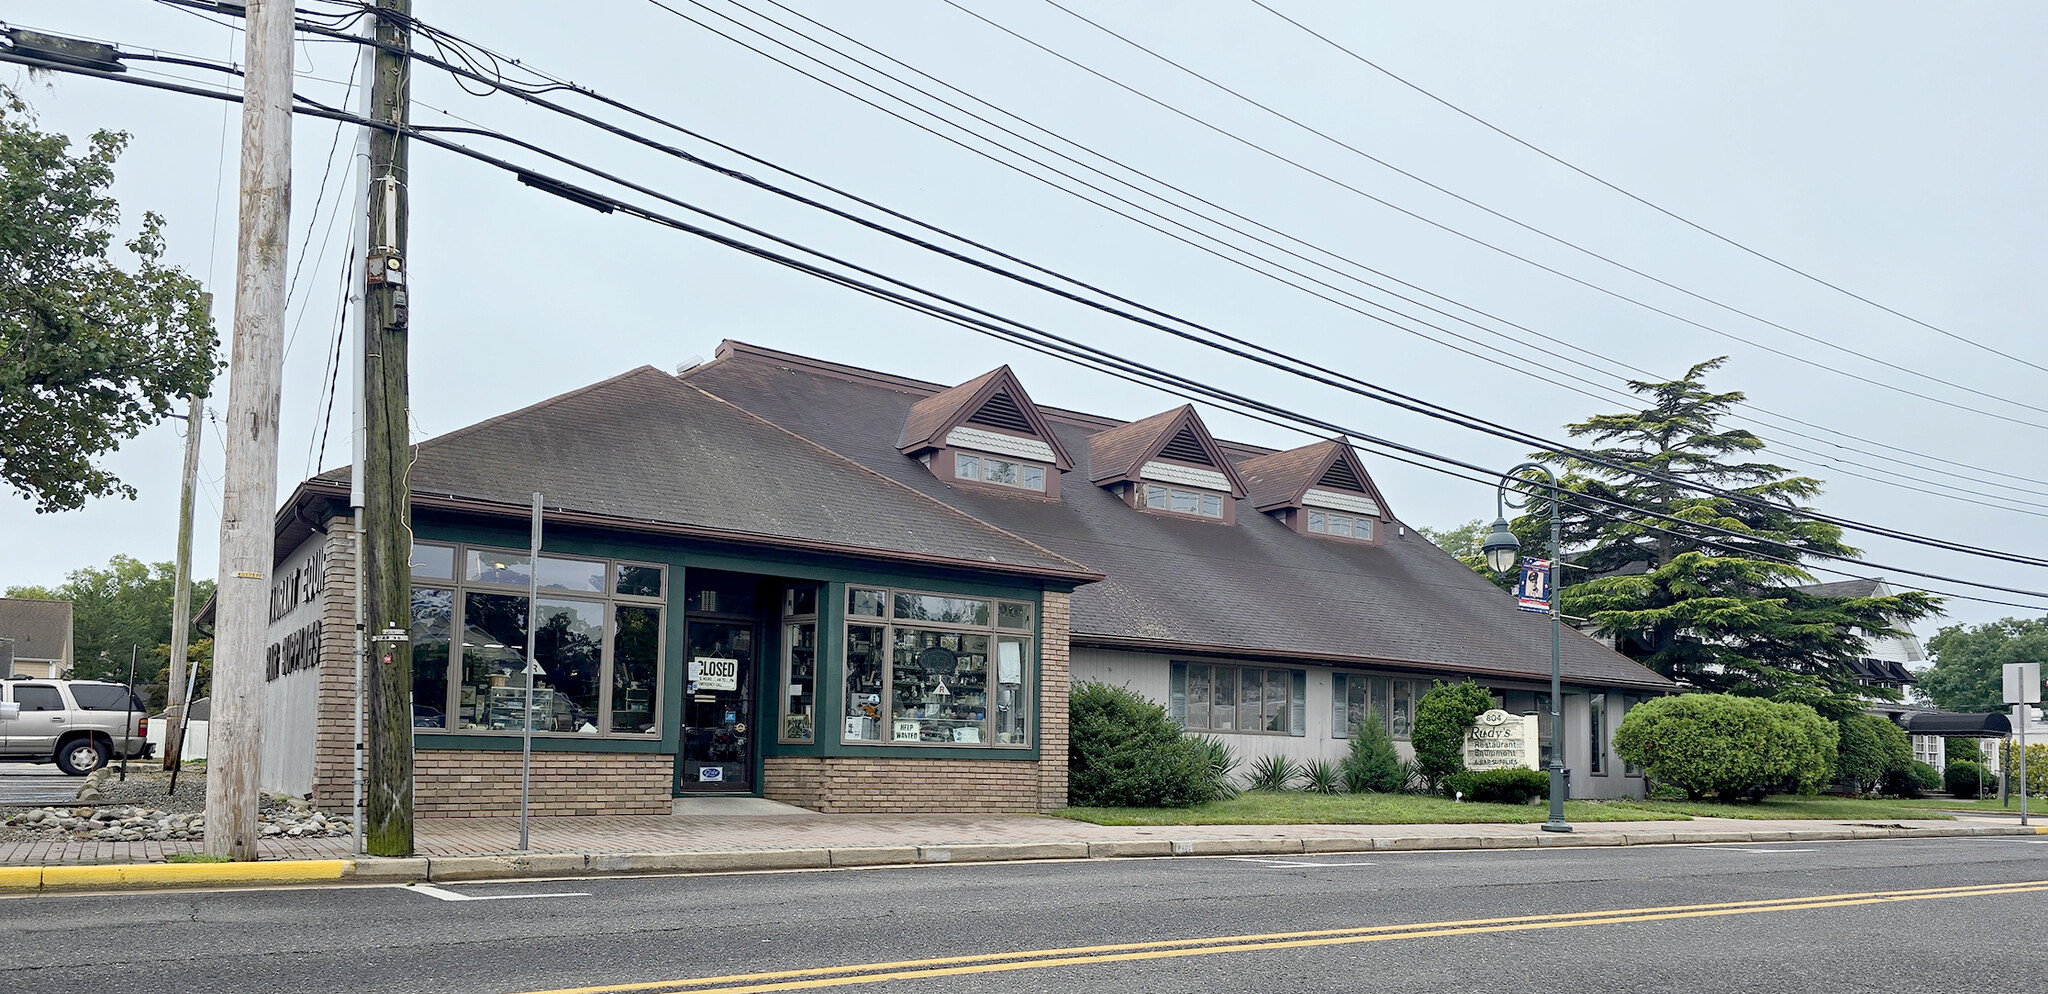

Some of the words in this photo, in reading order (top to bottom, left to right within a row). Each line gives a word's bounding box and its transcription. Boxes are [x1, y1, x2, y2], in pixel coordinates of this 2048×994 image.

[269, 567, 301, 627] AURANT
[302, 546, 327, 603] EQUIP
[281, 619, 322, 677] SUPPLIES
[697, 660, 735, 677] CLOSED
[939, 685, 945, 693] R
[1486, 714, 1502, 722] 804
[900, 723, 914, 731] HELP
[896, 732, 917, 740] WANTED
[1468, 726, 1511, 741] Rudy's
[1474, 749, 1516, 757] Equipment
